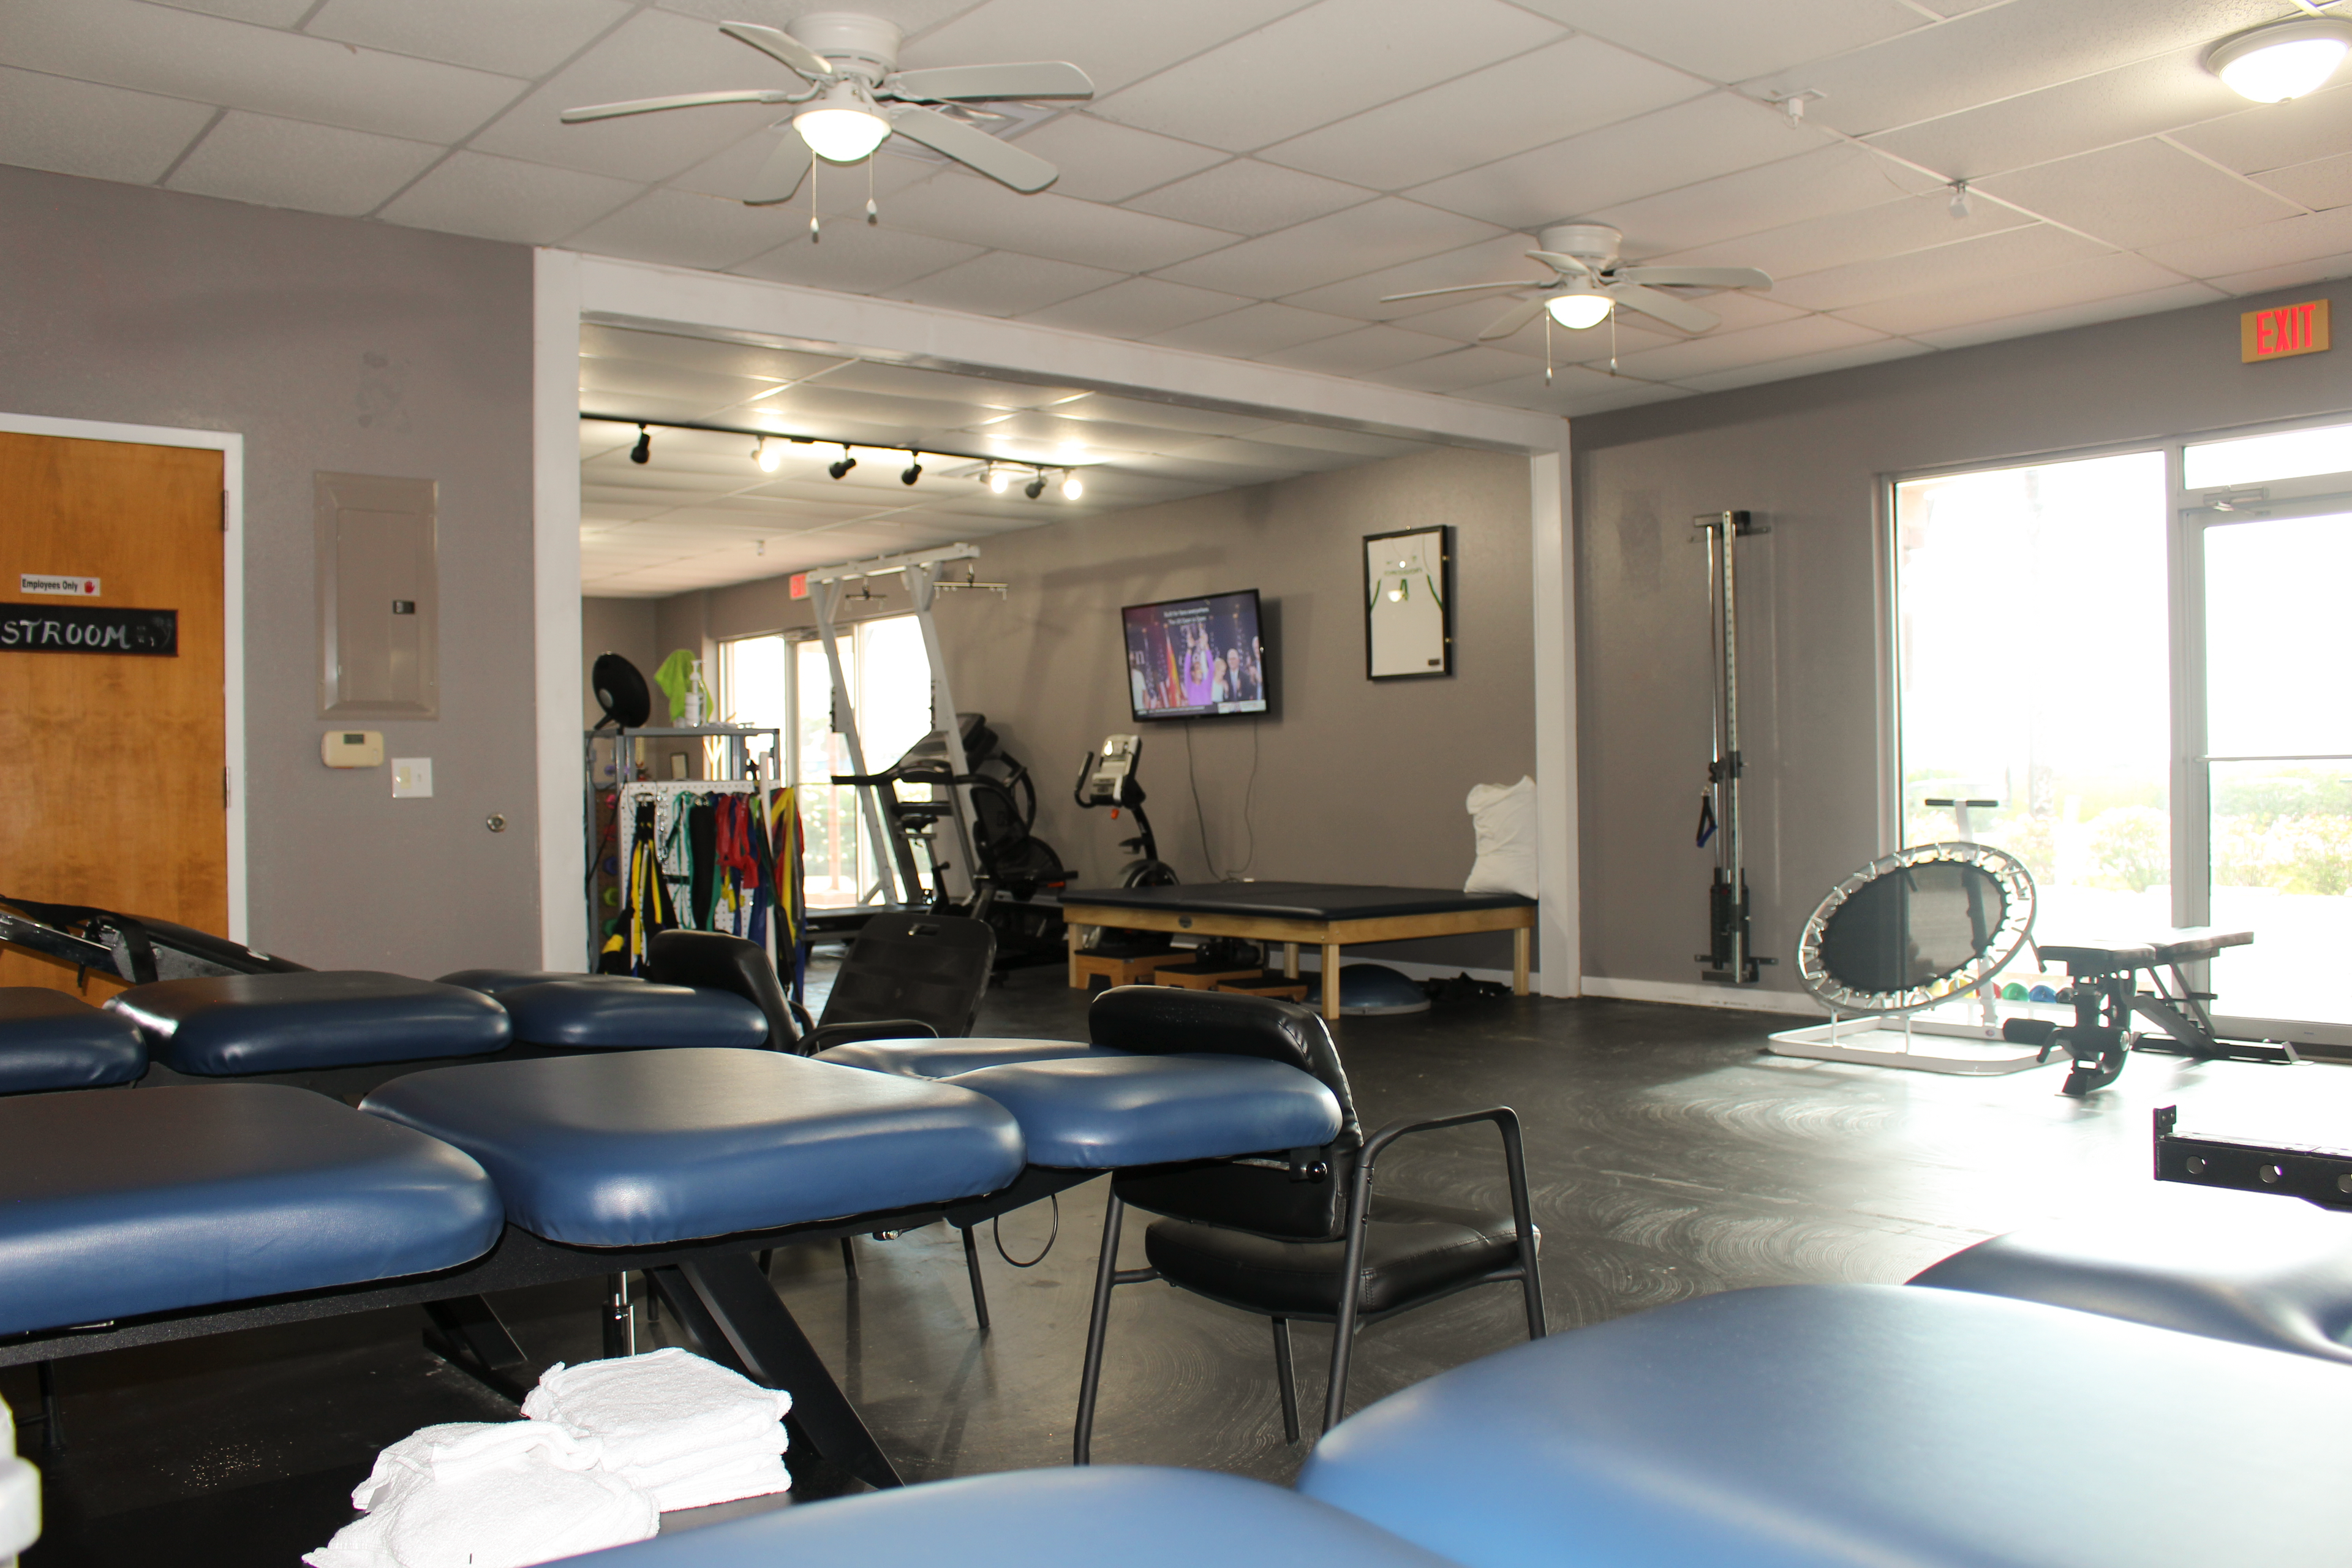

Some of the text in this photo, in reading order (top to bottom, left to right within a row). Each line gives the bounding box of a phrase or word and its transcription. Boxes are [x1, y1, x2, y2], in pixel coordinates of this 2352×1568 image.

[2257, 304, 2316, 355] EXIT
[22, 579, 78, 592] Employees Only
[1, 618, 130, 649] STROOM
